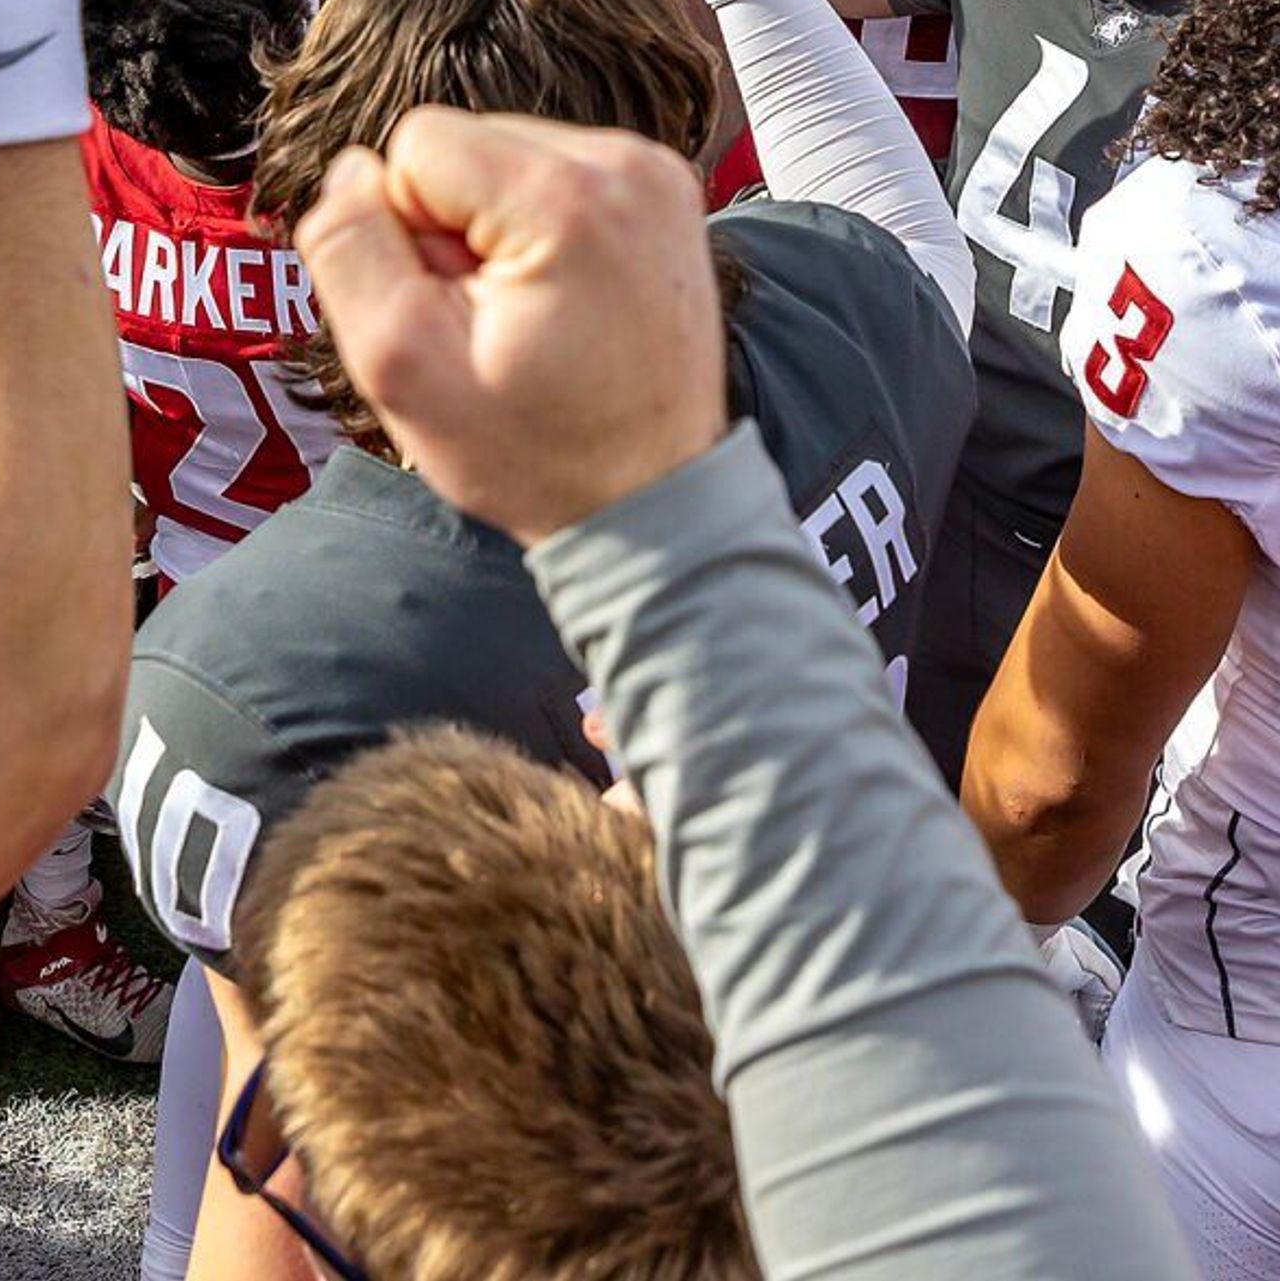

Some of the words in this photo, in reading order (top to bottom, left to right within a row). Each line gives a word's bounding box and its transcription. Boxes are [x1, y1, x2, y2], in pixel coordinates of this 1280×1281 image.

[957, 33, 1088, 333] 4
[91, 212, 319, 336] ARKER
[1082, 261, 1176, 420] 3
